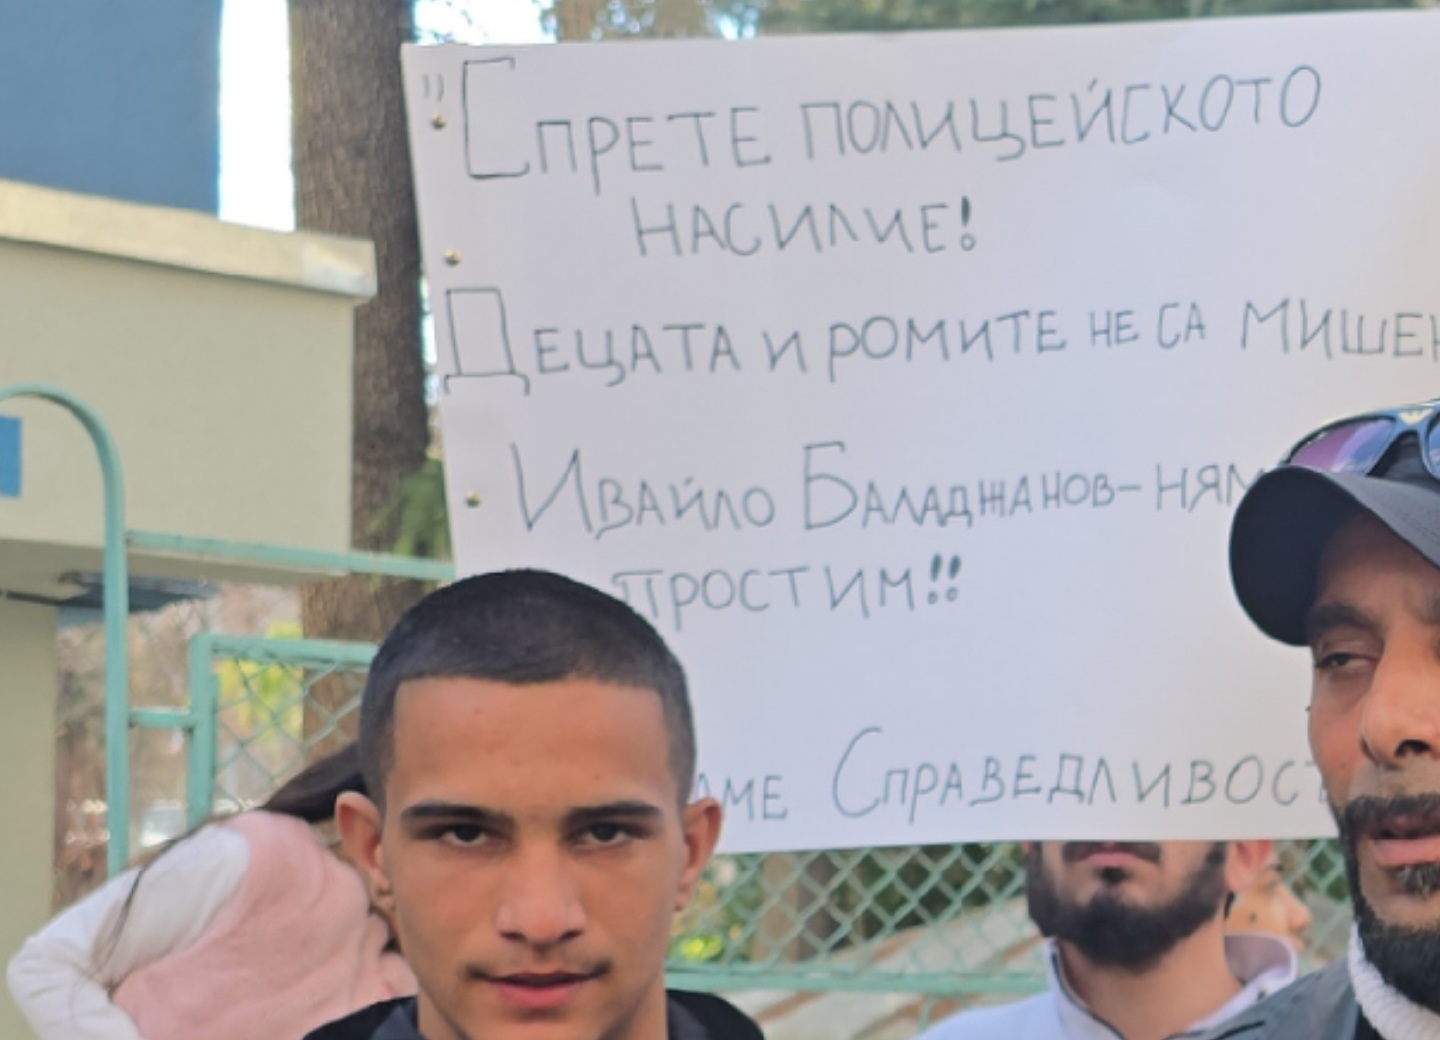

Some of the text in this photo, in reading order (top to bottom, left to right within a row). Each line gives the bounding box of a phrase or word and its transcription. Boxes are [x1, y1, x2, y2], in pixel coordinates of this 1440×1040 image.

[800, 65, 1321, 161] ПОЛИЦЕЙСКОТО
[631, 196, 977, 257] НАСИЛИЕ!
[762, 329, 808, 374] И
[828, 310, 1067, 383] РОМИТЕ
[1089, 308, 1140, 349] НЕ
[1156, 300, 1206, 350] СА
[610, 554, 962, 632] ПРОСТИМ!!
